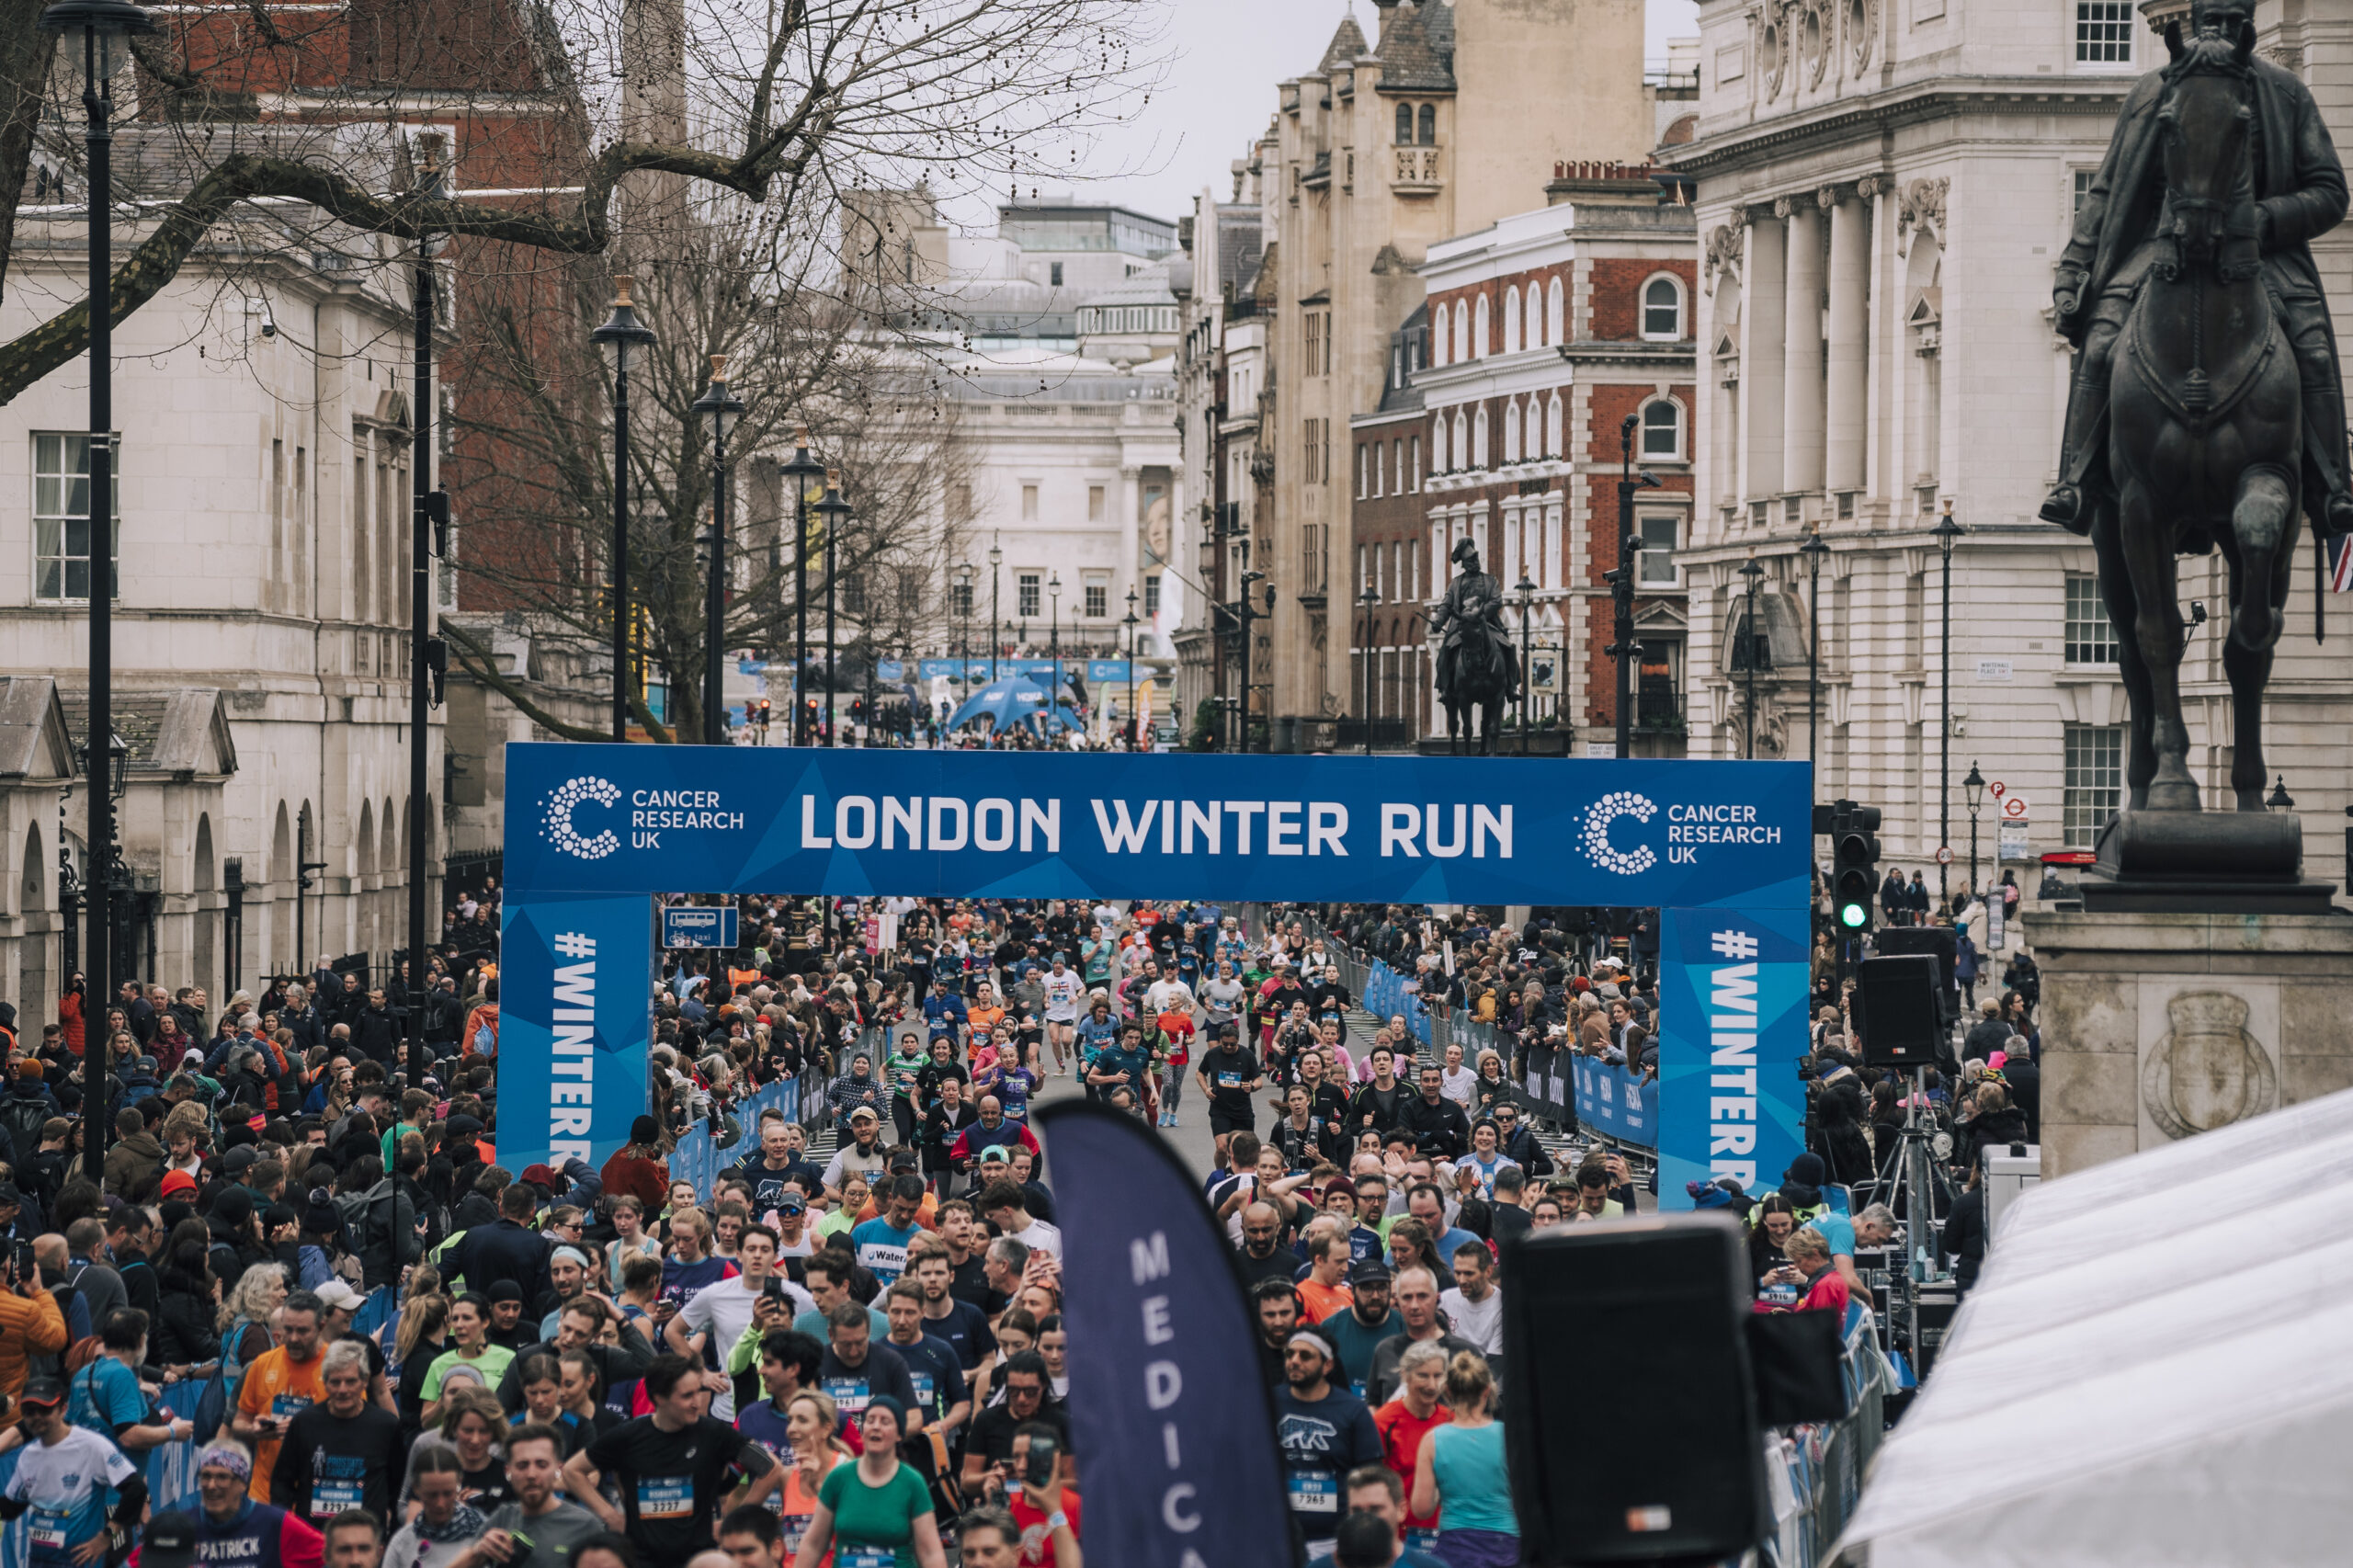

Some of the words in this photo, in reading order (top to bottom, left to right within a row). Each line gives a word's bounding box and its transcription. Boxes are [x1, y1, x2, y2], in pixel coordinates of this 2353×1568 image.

[631, 790, 720, 809] CANCER
[631, 811, 745, 830] RESEARCH
[1668, 804, 1756, 823] CANCER
[801, 794, 1061, 853] LONDON
[1090, 799, 1349, 857] WINTER
[1381, 802, 1513, 858] RUN
[1668, 825, 1780, 844] RESEARCH
[631, 831, 661, 849] UK
[1668, 846, 1697, 864] UK
[694, 933, 711, 942] taxi
[868, 923, 878, 936] EXIT
[653, 1501, 680, 1513] 3227
[199, 1536, 260, 1561] PATRICK
